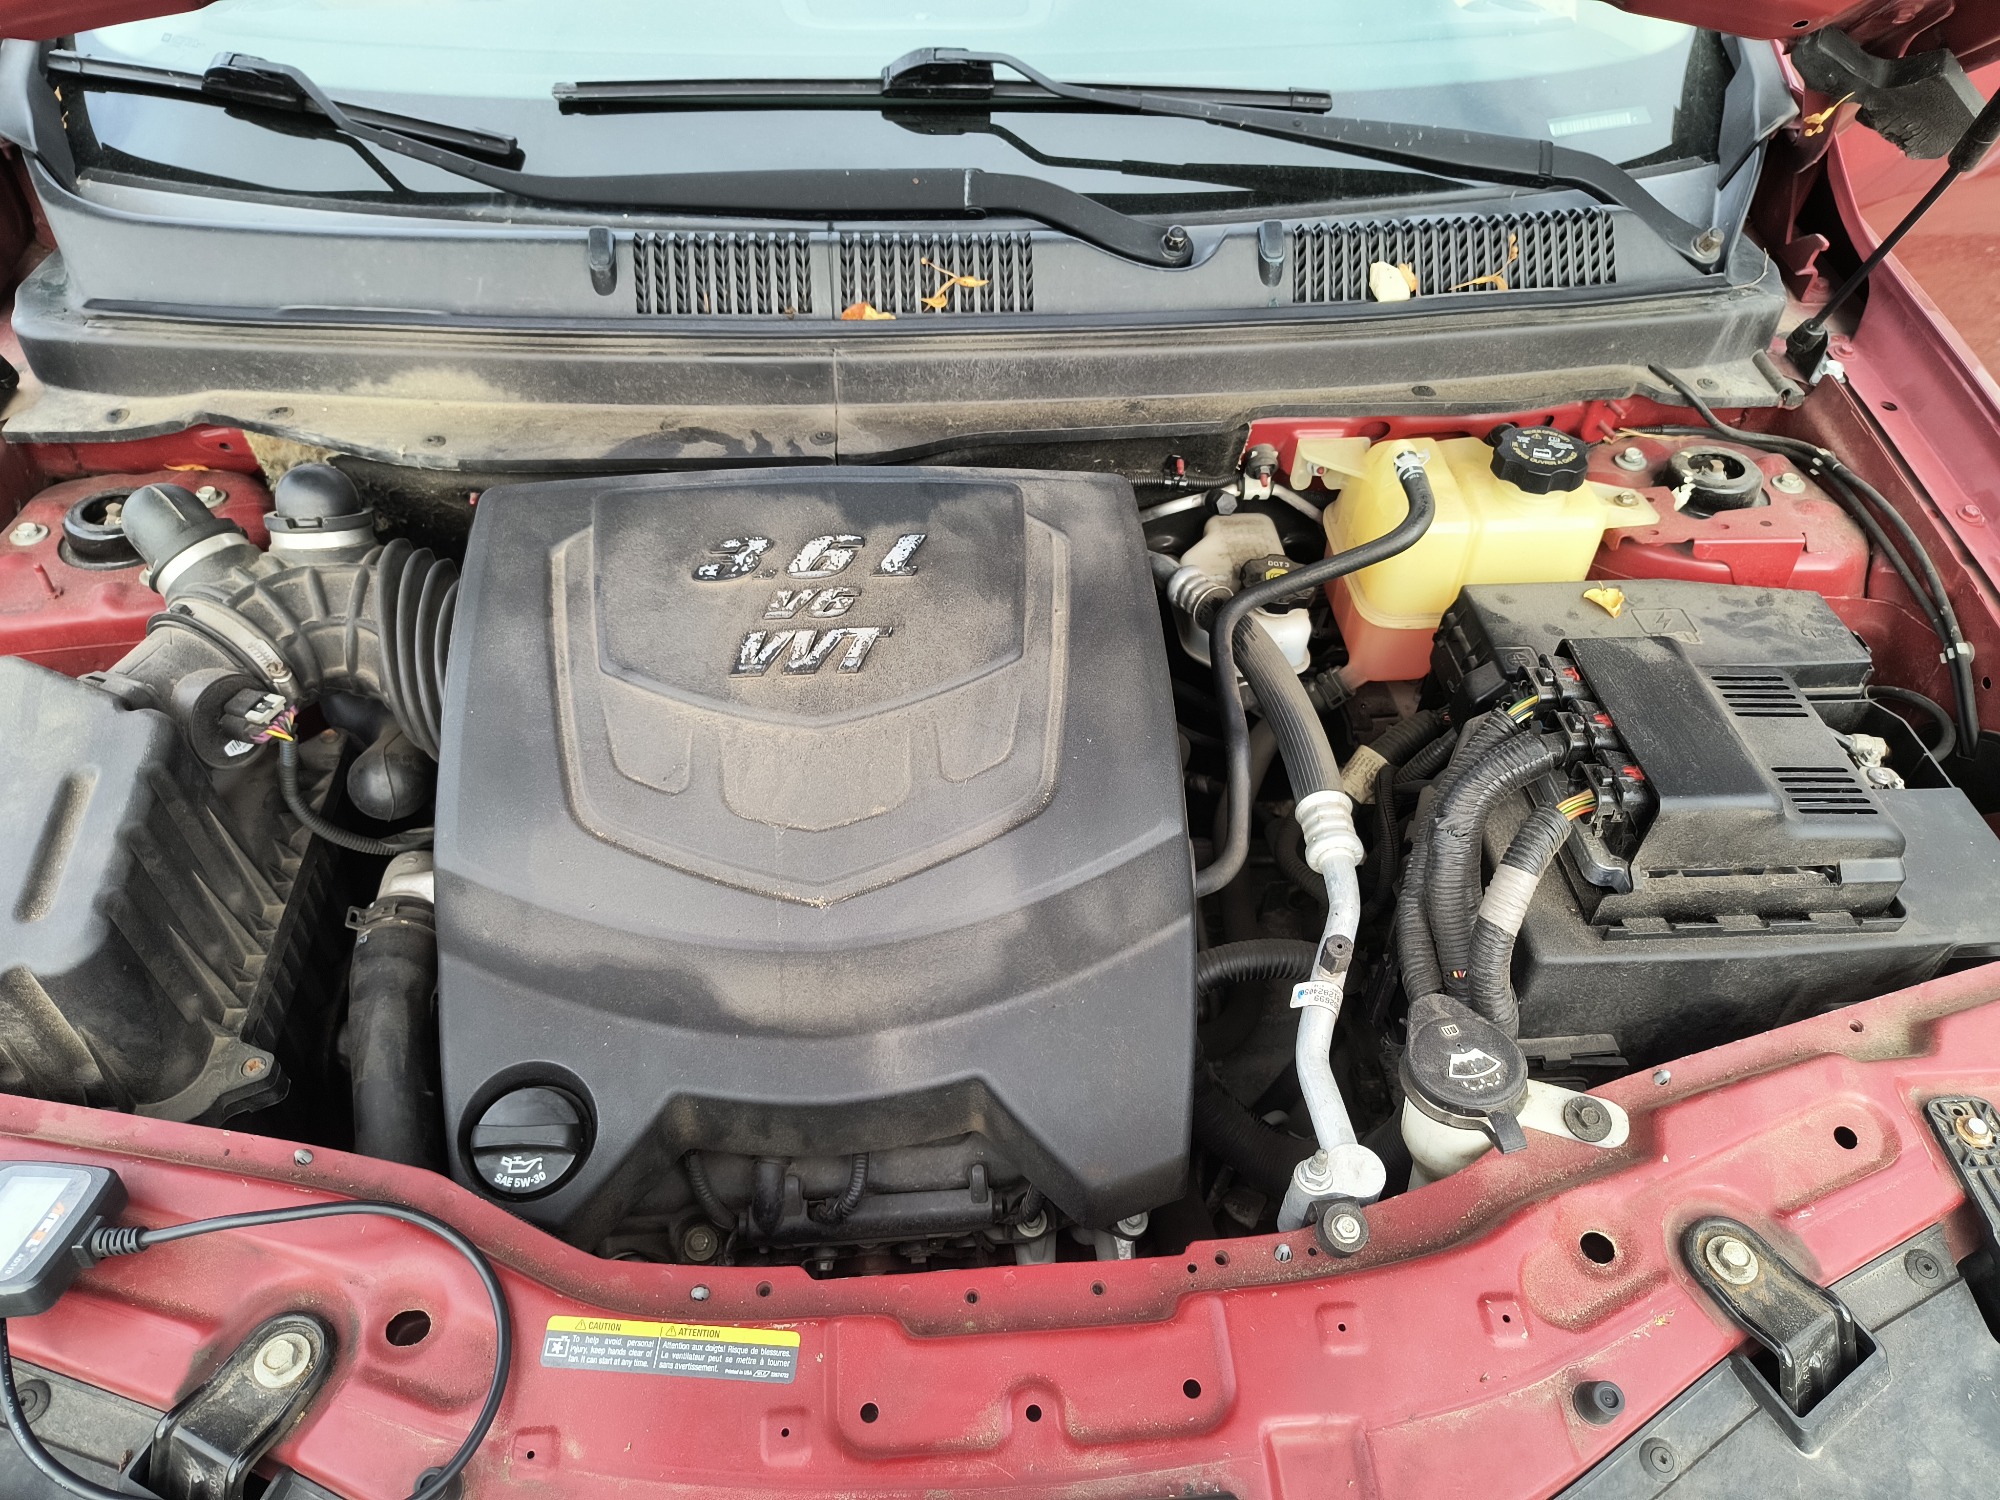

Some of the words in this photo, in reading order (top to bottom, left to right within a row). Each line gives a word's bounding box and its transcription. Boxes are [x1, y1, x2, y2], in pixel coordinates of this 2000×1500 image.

[762, 587, 863, 620] V6
[728, 626, 894, 678] VVT
[493, 1172, 514, 1188] SAE
[513, 1171, 547, 1188] 5W-30
[4, 1252, 25, 1275] AD310
[588, 1321, 622, 1331] CAUTION
[678, 1327, 720, 1338] ATTENTION
[572, 1335, 580, 1343] To
[585, 1336, 599, 1345] help
[626, 1340, 655, 1348] personal
[662, 1340, 690, 1351] Attention
[691, 1343, 704, 1351] aux
[705, 1343, 726, 1354] doigts!
[727, 1345, 748, 1355] Risque
[750, 1346, 759, 1355] de
[760, 1348, 791, 1358] blessures.
[590, 1346, 606, 1355] keep
[607, 1347, 627, 1356] hands
[628, 1348, 644, 1357] clear
[645, 1349, 653, 1358] of
[660, 1350, 669, 1359] Le
[672, 1351, 706, 1361] ventilateur
[707, 1353, 723, 1363] peut
[725, 1355, 733, 1364] se
[735, 1356, 757, 1365] mettre
[767, 1358, 791, 1367] tourner
[598, 1357, 613, 1365] start
[613, 1358, 620, 1366] at
[621, 1359, 633, 1368] any
[659, 1361, 674, 1369] sans
[673, 1363, 719, 1373] avertissement.
